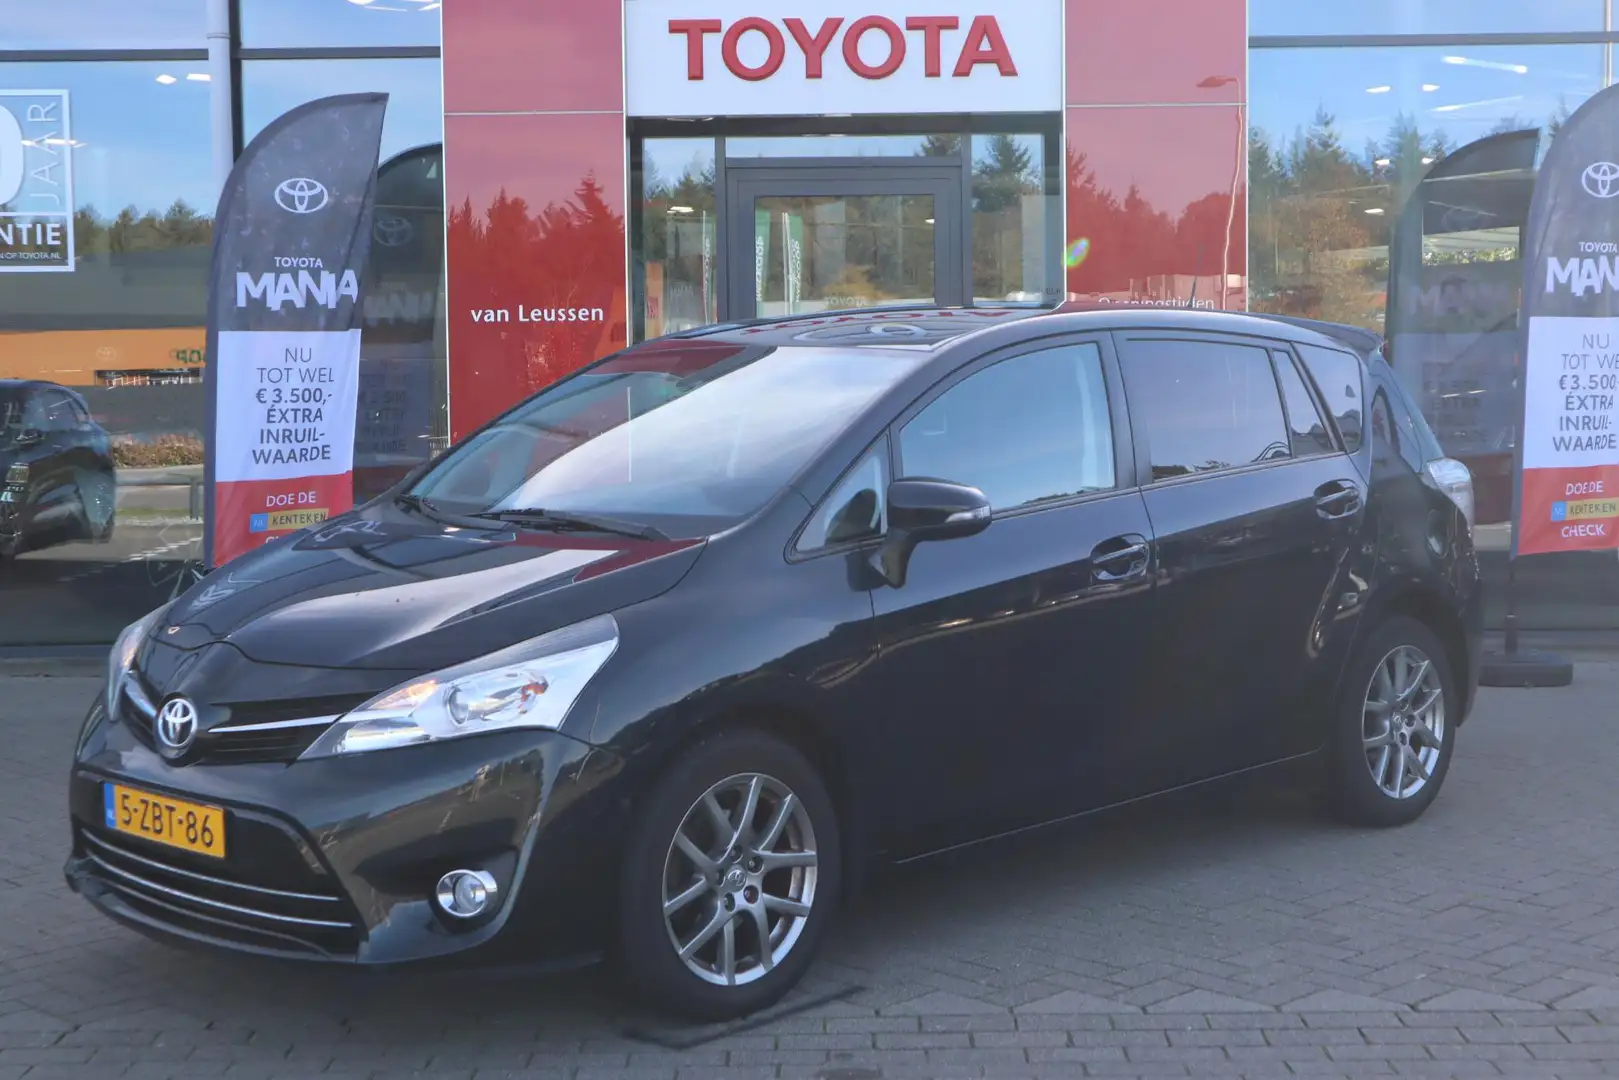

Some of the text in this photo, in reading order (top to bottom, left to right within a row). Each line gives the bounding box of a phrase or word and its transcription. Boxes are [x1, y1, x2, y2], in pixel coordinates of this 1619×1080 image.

[668, 15, 1019, 82] TOYOTA
[27, 102, 60, 206] JAAR
[18, 251, 62, 260] TOYOTA.NL
[1579, 241, 1618, 253] TOYOTA
[274, 256, 323, 268] TOYOTA
[236, 269, 359, 311] MANIA
[470, 304, 604, 323] van Leussen
[1582, 333, 1610, 349] NU
[285, 347, 312, 363] NU
[1561, 353, 1590, 370] TOT
[256, 367, 335, 384] TOT WEL
[1565, 391, 1614, 411] ÉXTRA
[266, 404, 323, 424] ÉXTRA
[1560, 415, 1612, 431] INRUIL-
[260, 427, 326, 445] INRUIL-
[1552, 434, 1617, 452] WAARDE
[252, 444, 332, 465] WAARDE
[266, 490, 316, 507] DOE DE
[271, 511, 327, 526] KENTEKEN
[1561, 523, 1606, 538] CHECK
[121, 793, 214, 849] 5-ZBT-86
